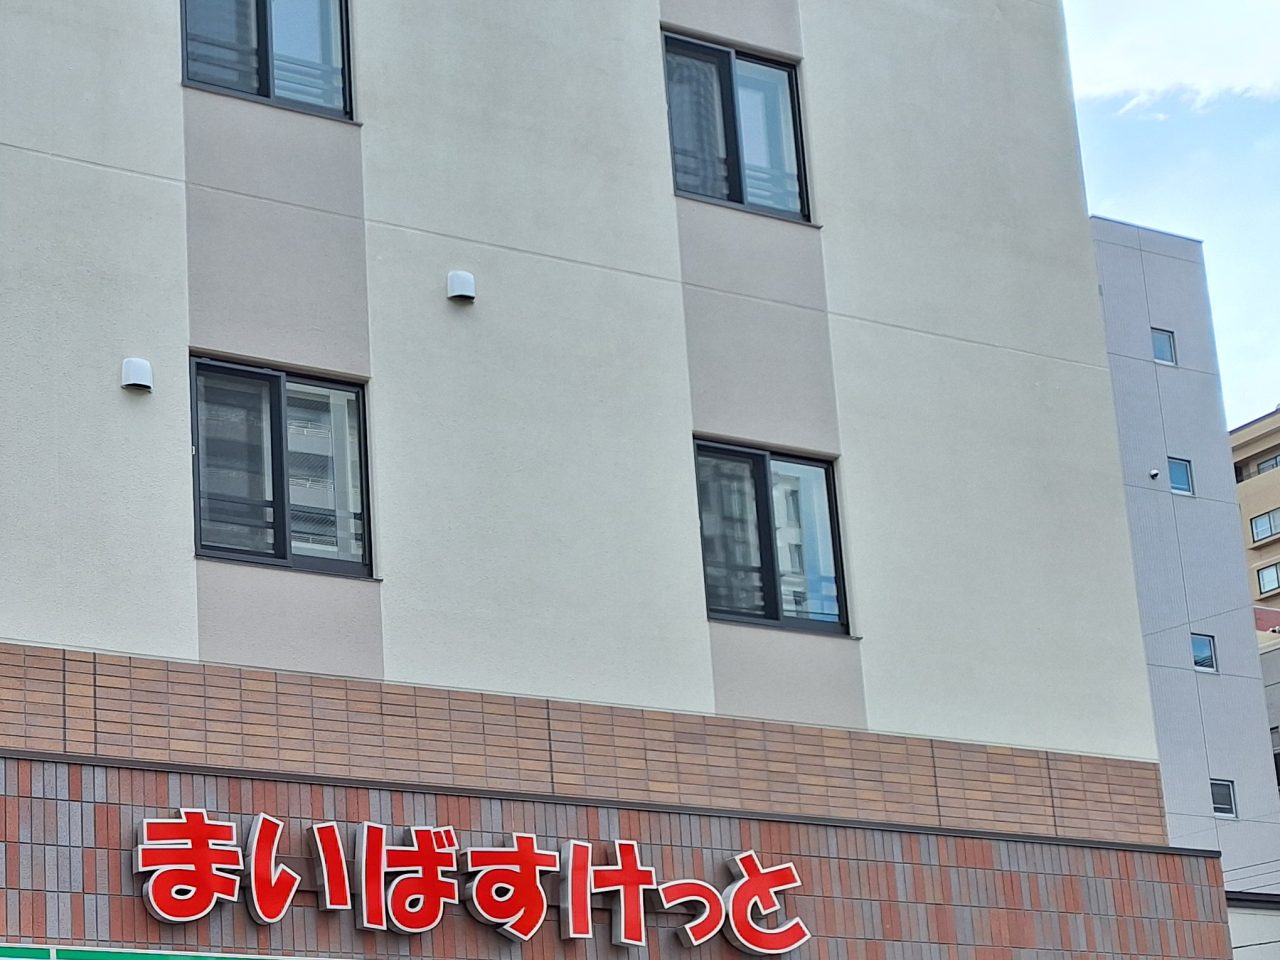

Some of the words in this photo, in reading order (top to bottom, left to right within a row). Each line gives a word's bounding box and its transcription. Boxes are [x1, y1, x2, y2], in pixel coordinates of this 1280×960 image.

[134, 807, 812, 956] まいばすけっと
